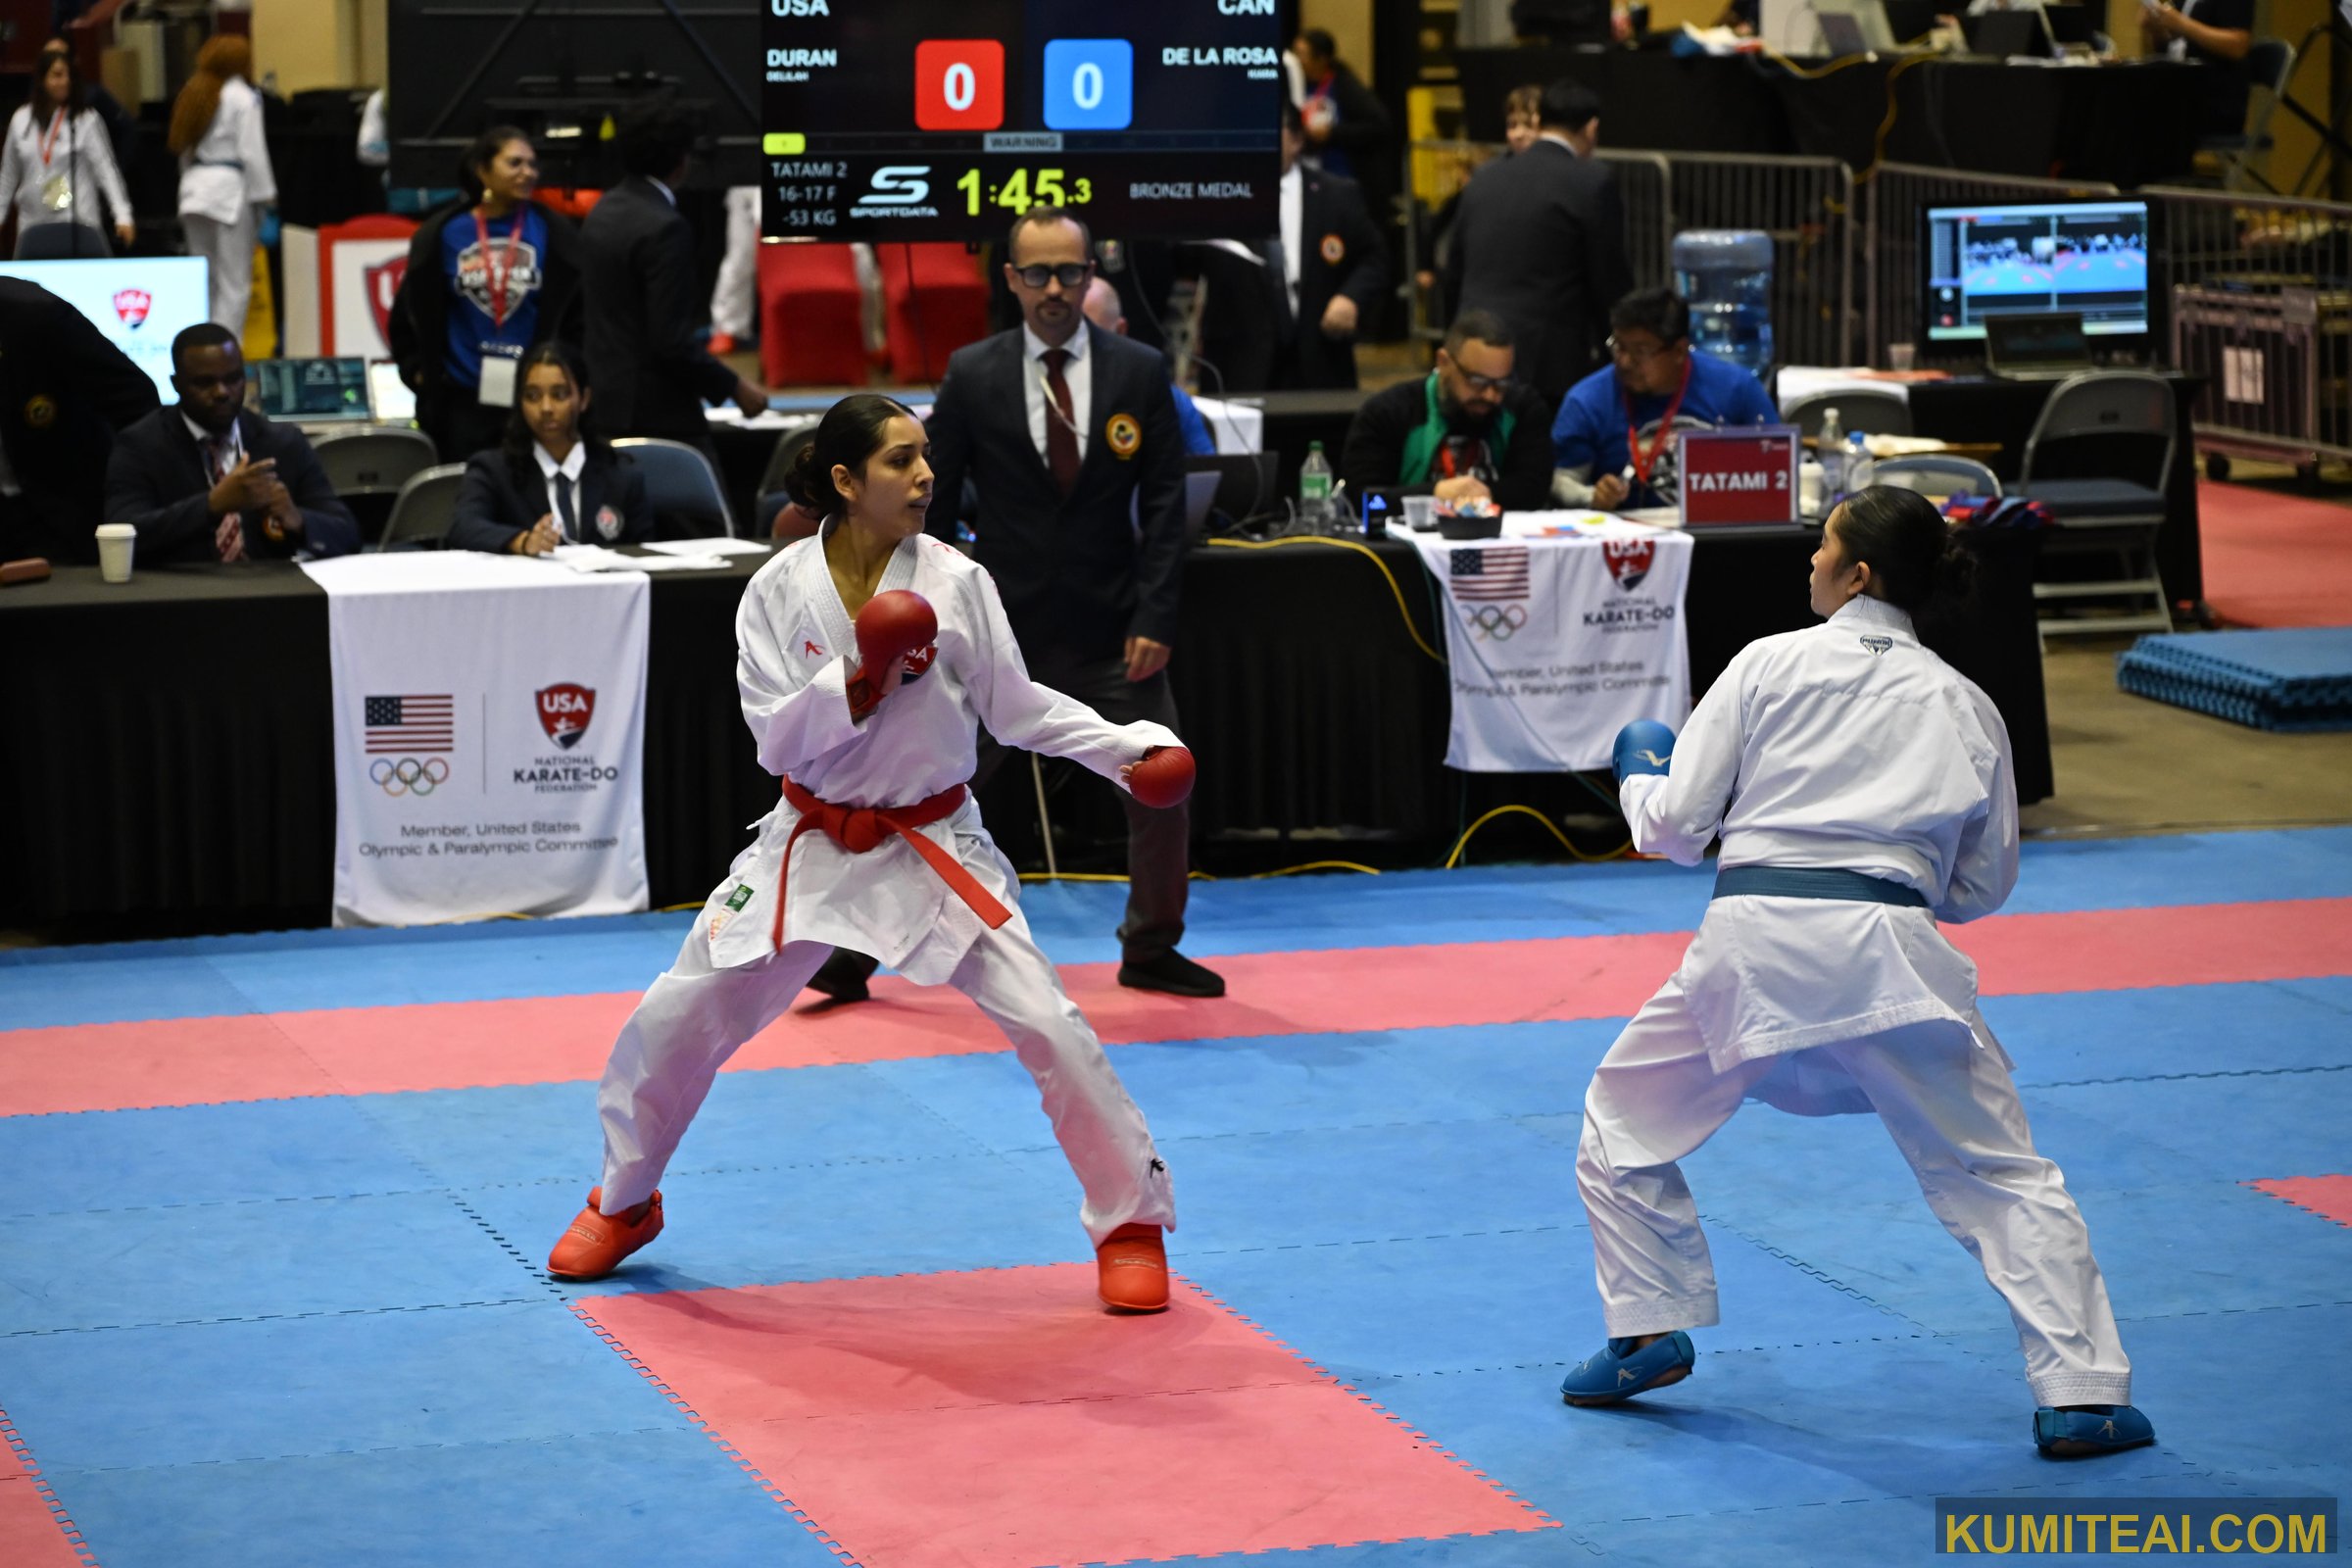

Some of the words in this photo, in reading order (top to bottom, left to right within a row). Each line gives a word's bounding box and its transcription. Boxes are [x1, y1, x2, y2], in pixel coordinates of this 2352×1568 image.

[771, 0, 829, 17] USA
[1217, 0, 1275, 15] CAN
[766, 49, 837, 67] DURAN
[1162, 47, 1190, 66] DE
[1194, 47, 1219, 65] LA
[1223, 47, 1278, 65] ROSA
[944, 63, 976, 111] 0
[1072, 63, 1103, 110] 0
[991, 136, 1057, 148] WARNING
[771, 162, 833, 178] TATAMI
[836, 162, 848, 177] 2
[778, 186, 823, 201] 16-17
[827, 186, 836, 201] F
[1129, 182, 1195, 199] BRONZE
[1198, 182, 1253, 198] MEDAL
[813, 210, 836, 225] KG
[850, 207, 939, 218] SPORTDATA
[1689, 472, 1767, 491] TATAMI
[1776, 470, 1788, 489] 2
[543, 692, 588, 713] USA
[534, 755, 596, 766] NATIONAL
[513, 766, 618, 783] KARATE-DO
[400, 824, 470, 838] Member,
[476, 822, 527, 837] United
[531, 820, 581, 835] States
[358, 843, 422, 859] Olympic
[427, 843, 440, 856] &
[444, 840, 530, 858] Paralympic
